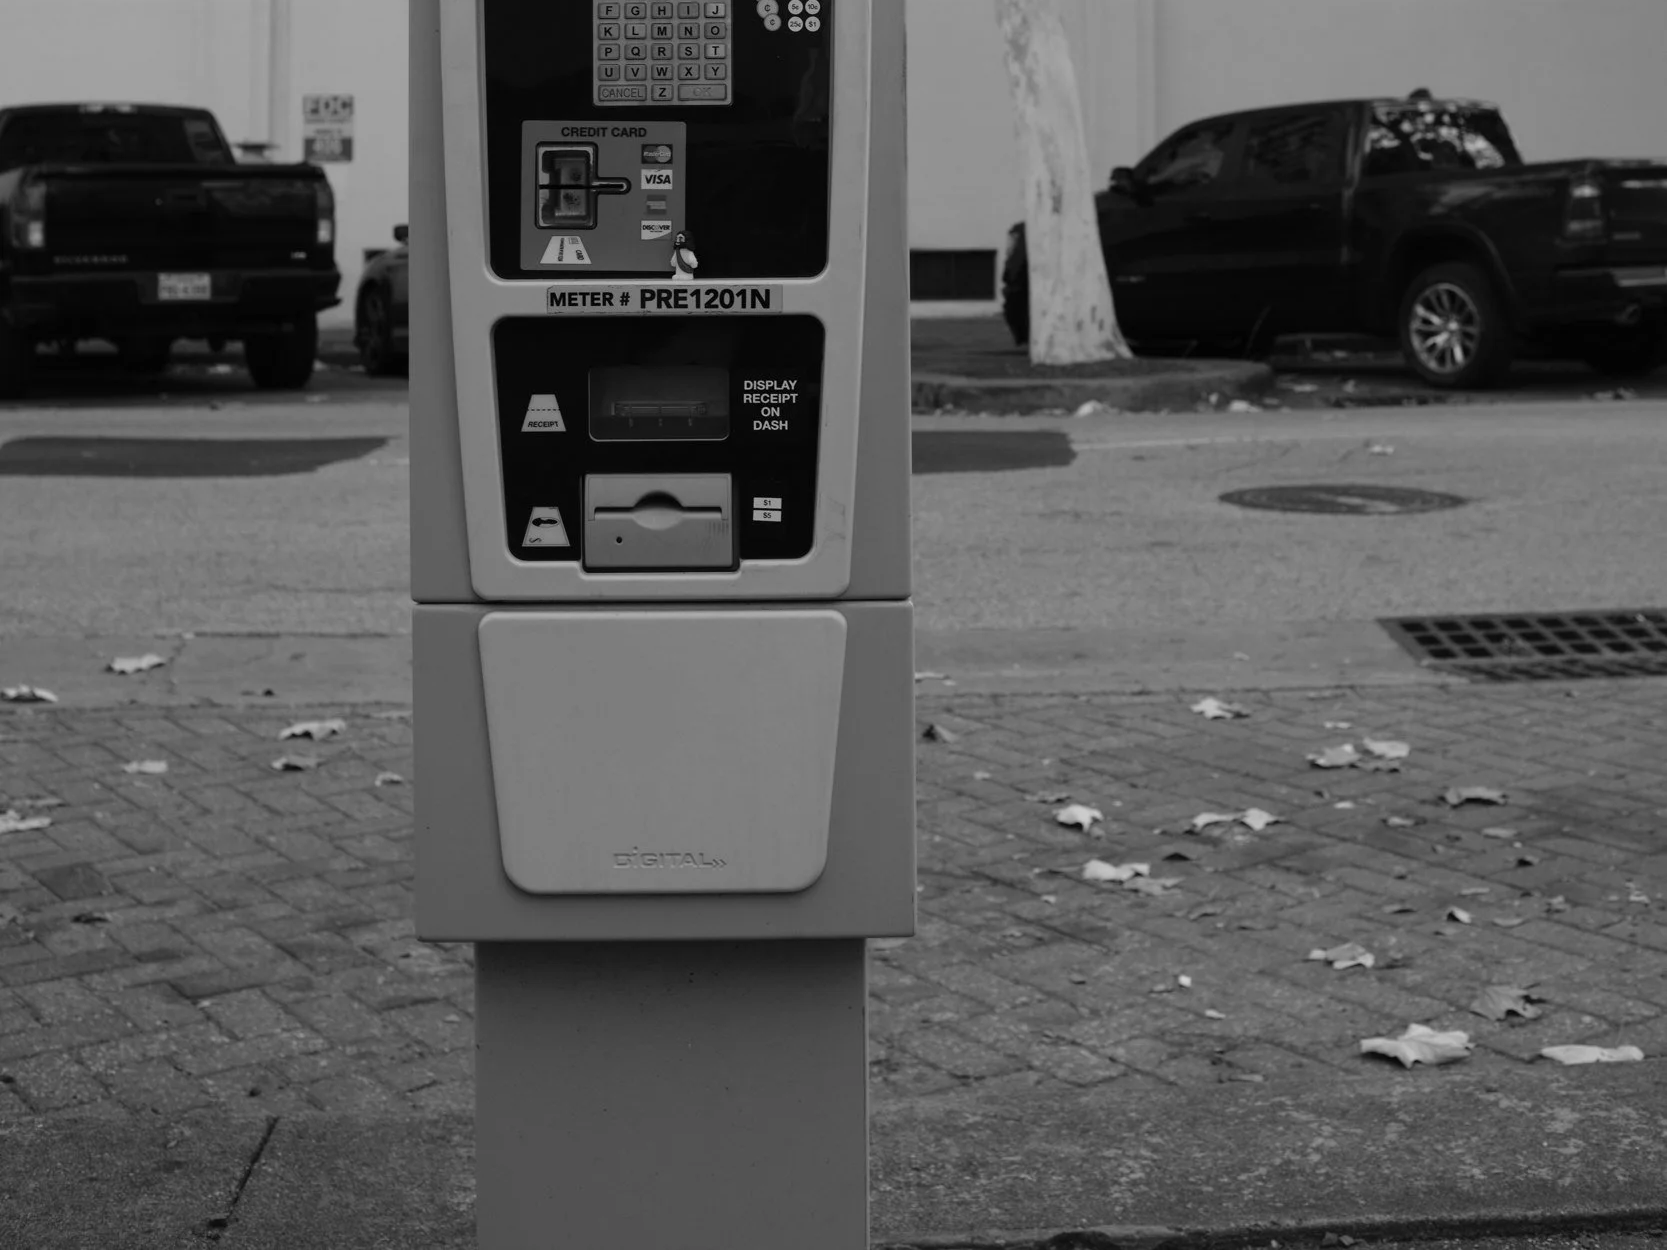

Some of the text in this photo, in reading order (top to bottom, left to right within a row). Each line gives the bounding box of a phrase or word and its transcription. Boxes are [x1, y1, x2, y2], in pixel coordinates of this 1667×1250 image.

[605, 5, 719, 16] F G H I J
[604, 26, 720, 37] K L M N O
[631, 46, 641, 57] Q
[658, 47, 666, 57] R
[685, 46, 693, 57] S
[712, 46, 720, 56] T
[605, 66, 720, 78] U V W X Y
[601, 87, 667, 99] CANCEL Z
[561, 127, 647, 137] CREDIT CARD
[645, 174, 671, 184] VISA
[550, 292, 614, 307] METER
[640, 288, 770, 309] PRE1201N
[744, 380, 797, 390] DISPLAY
[743, 393, 798, 404] RECEIPT
[761, 406, 780, 417] ON
[753, 420, 788, 430] DASH
